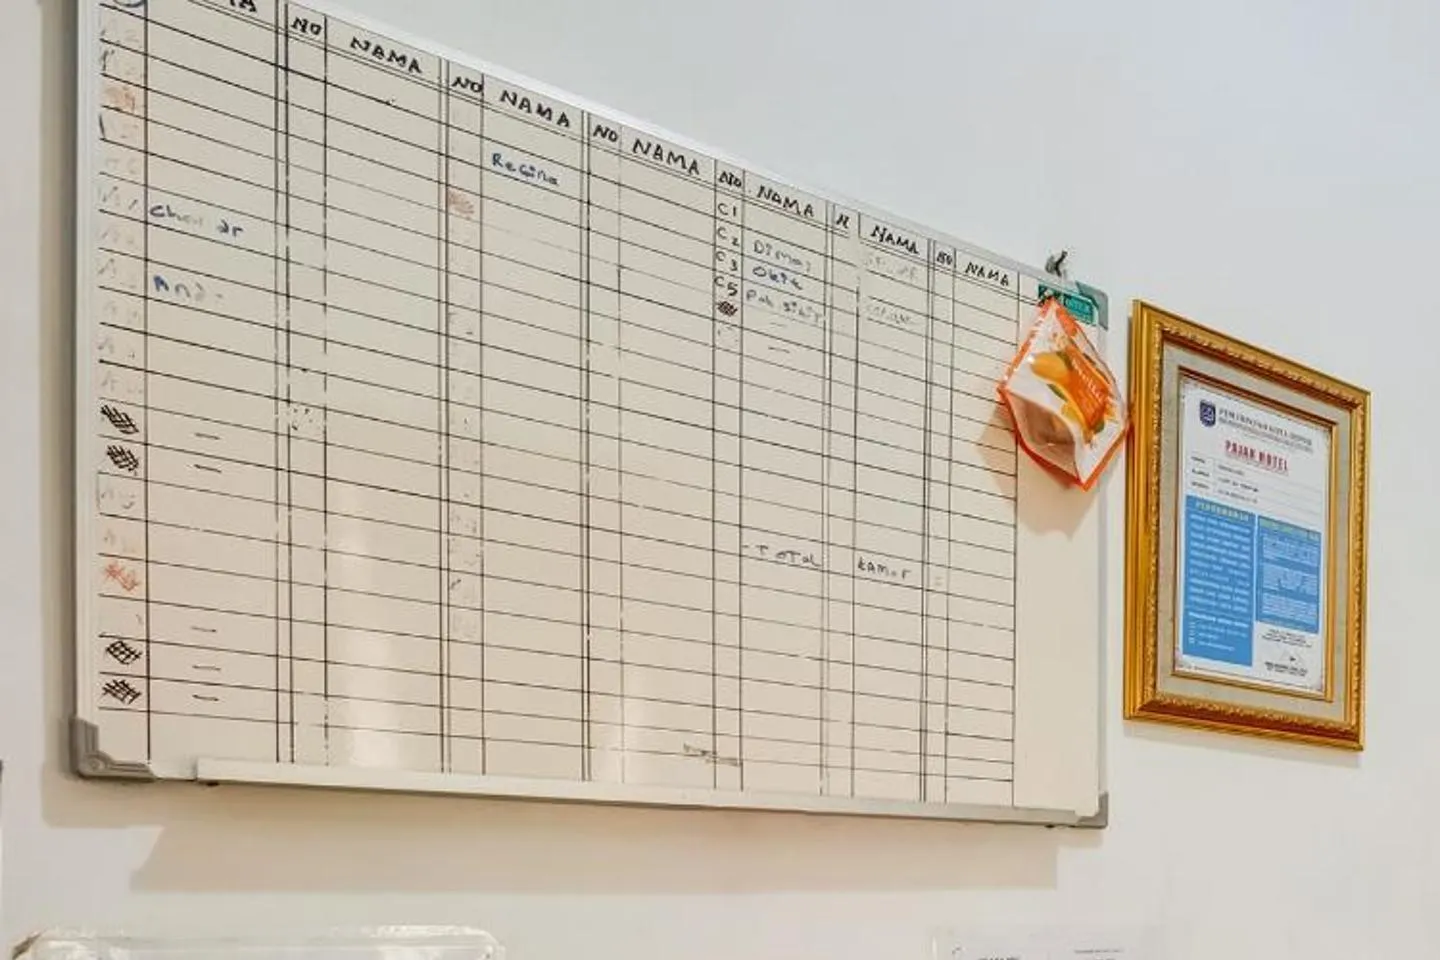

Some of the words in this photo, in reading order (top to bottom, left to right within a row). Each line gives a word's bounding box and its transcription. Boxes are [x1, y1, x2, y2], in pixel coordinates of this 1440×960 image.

[291, 16, 322, 36] NO
[350, 36, 422, 75] NAMA
[452, 75, 482, 94] NO
[500, 89, 571, 128] NAMA
[593, 125, 618, 143] NO
[632, 138, 700, 176] NAMA
[718, 171, 743, 189] NO
[756, 185, 815, 219] NAMA
[870, 225, 919, 254] NAMA
[965, 262, 1010, 287] NAMA
